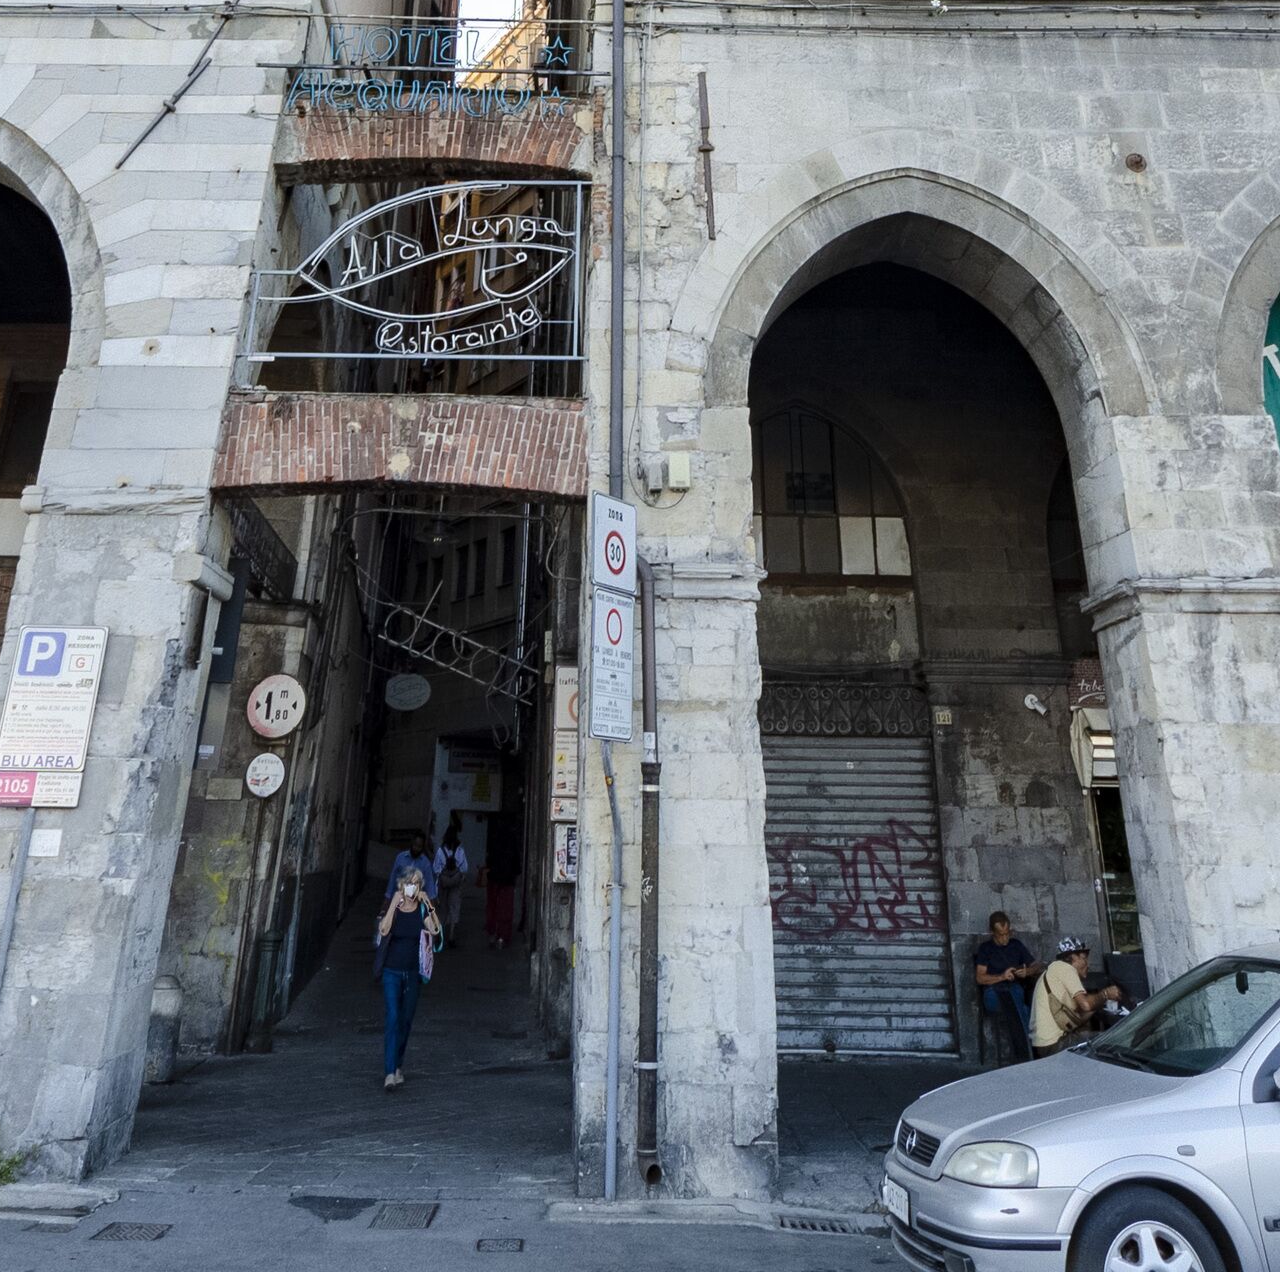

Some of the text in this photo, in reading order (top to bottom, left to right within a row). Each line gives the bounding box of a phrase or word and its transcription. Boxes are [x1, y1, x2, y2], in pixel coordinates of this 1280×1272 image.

[329, 26, 493, 67] HOTEL
[285, 70, 531, 118] ACQUARIO
[340, 194, 576, 286] Alla Lunga
[380, 306, 540, 356] Ristorante
[608, 508, 624, 522] zona
[609, 543, 622, 563] 30
[25, 635, 57, 672] P
[75, 657, 86, 669] G
[280, 689, 289, 699] m
[1, 754, 75, 768] BLU AREA
